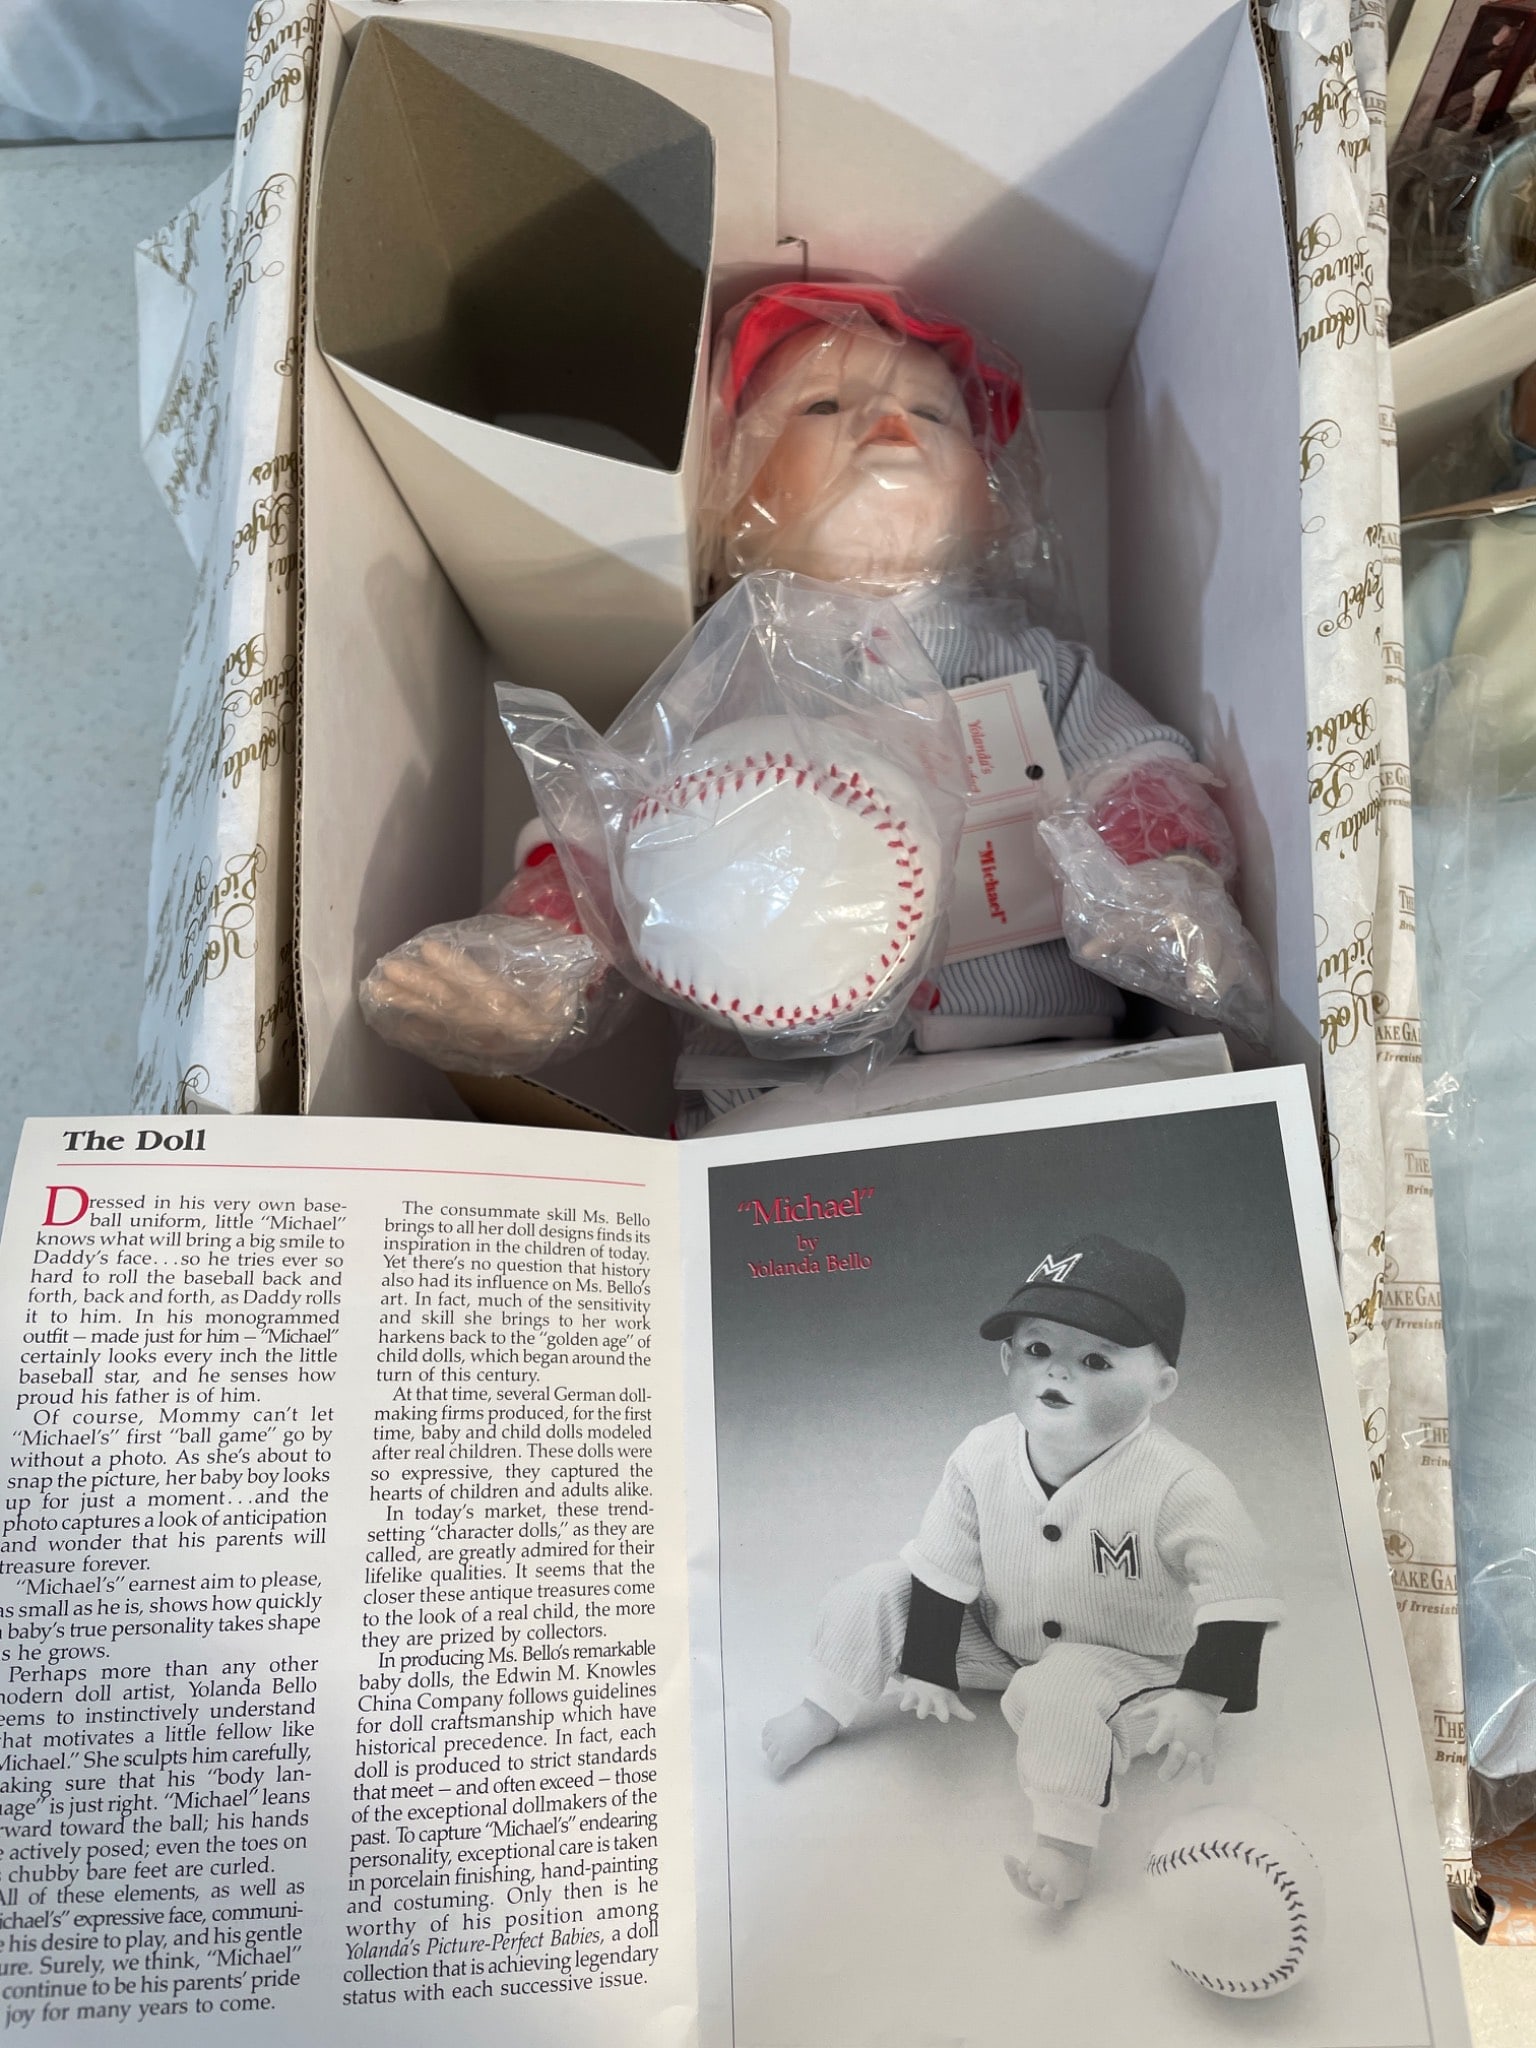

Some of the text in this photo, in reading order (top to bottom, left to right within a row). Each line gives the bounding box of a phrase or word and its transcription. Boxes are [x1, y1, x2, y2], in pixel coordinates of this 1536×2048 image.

[63, 1129, 207, 1152] The Doll
[155, 1195, 170, 1208] in
[179, 1195, 204, 1209] his
[214, 1200, 250, 1215] very
[259, 1201, 295, 1211] own
[304, 1198, 347, 1212] base-
[402, 1201, 650, 1226] The consummate skill Ms. Bello
[737, 1186, 875, 1226] "Michael"
[36, 1231, 344, 1253] knows what will bring a big smile to
[796, 1233, 819, 1255] by
[383, 1254, 650, 1278] Yet there's no question that history
[747, 1252, 872, 1279] Yolanda Bello
[1025, 1253, 1083, 1283] M
[26, 1308, 339, 1329] it to him. In his monogrammed
[21, 1347, 337, 1369] certainly looks every inch the little
[377, 1366, 539, 1387] turn of this century.
[34, 1406, 334, 1428] Of course, Mommy can't let
[13, 1426, 332, 1448] "Michael's" first "ball game" go by
[7, 1467, 329, 1494] snap the picture, her baby boy looks
[371, 1463, 653, 1485] so expressive, they captured the
[386, 1500, 653, 1525] In today's market, these trend-
[0, 1528, 325, 1553] and wonder that his parents will
[1090, 1528, 1141, 1580] M
[17, 1571, 321, 1595] "Michael's" earnest aim to please,
[362, 1623, 606, 1652] they are prized by collectors.
[8, 1655, 318, 1687] Perhaps more than any other
[360, 1660, 656, 1695] baby dolls, the Edwin M. Knowles
[76, 1684, 111, 1702] doll
[123, 1683, 174, 1701] artist,
[188, 1680, 260, 1698] Yolanda
[272, 1676, 317, 1694] Bello
[358, 1682, 656, 1712] China Company follows guidelines
[356, 1722, 656, 1758] historical precedence. In fact, each
[346, 1922, 658, 1960] Yolanda's Picture-Perfect Babies, a doll
[343, 1972, 647, 2006] status with each successive issue.
[6, 1997, 275, 2027] joy for many years to come.
